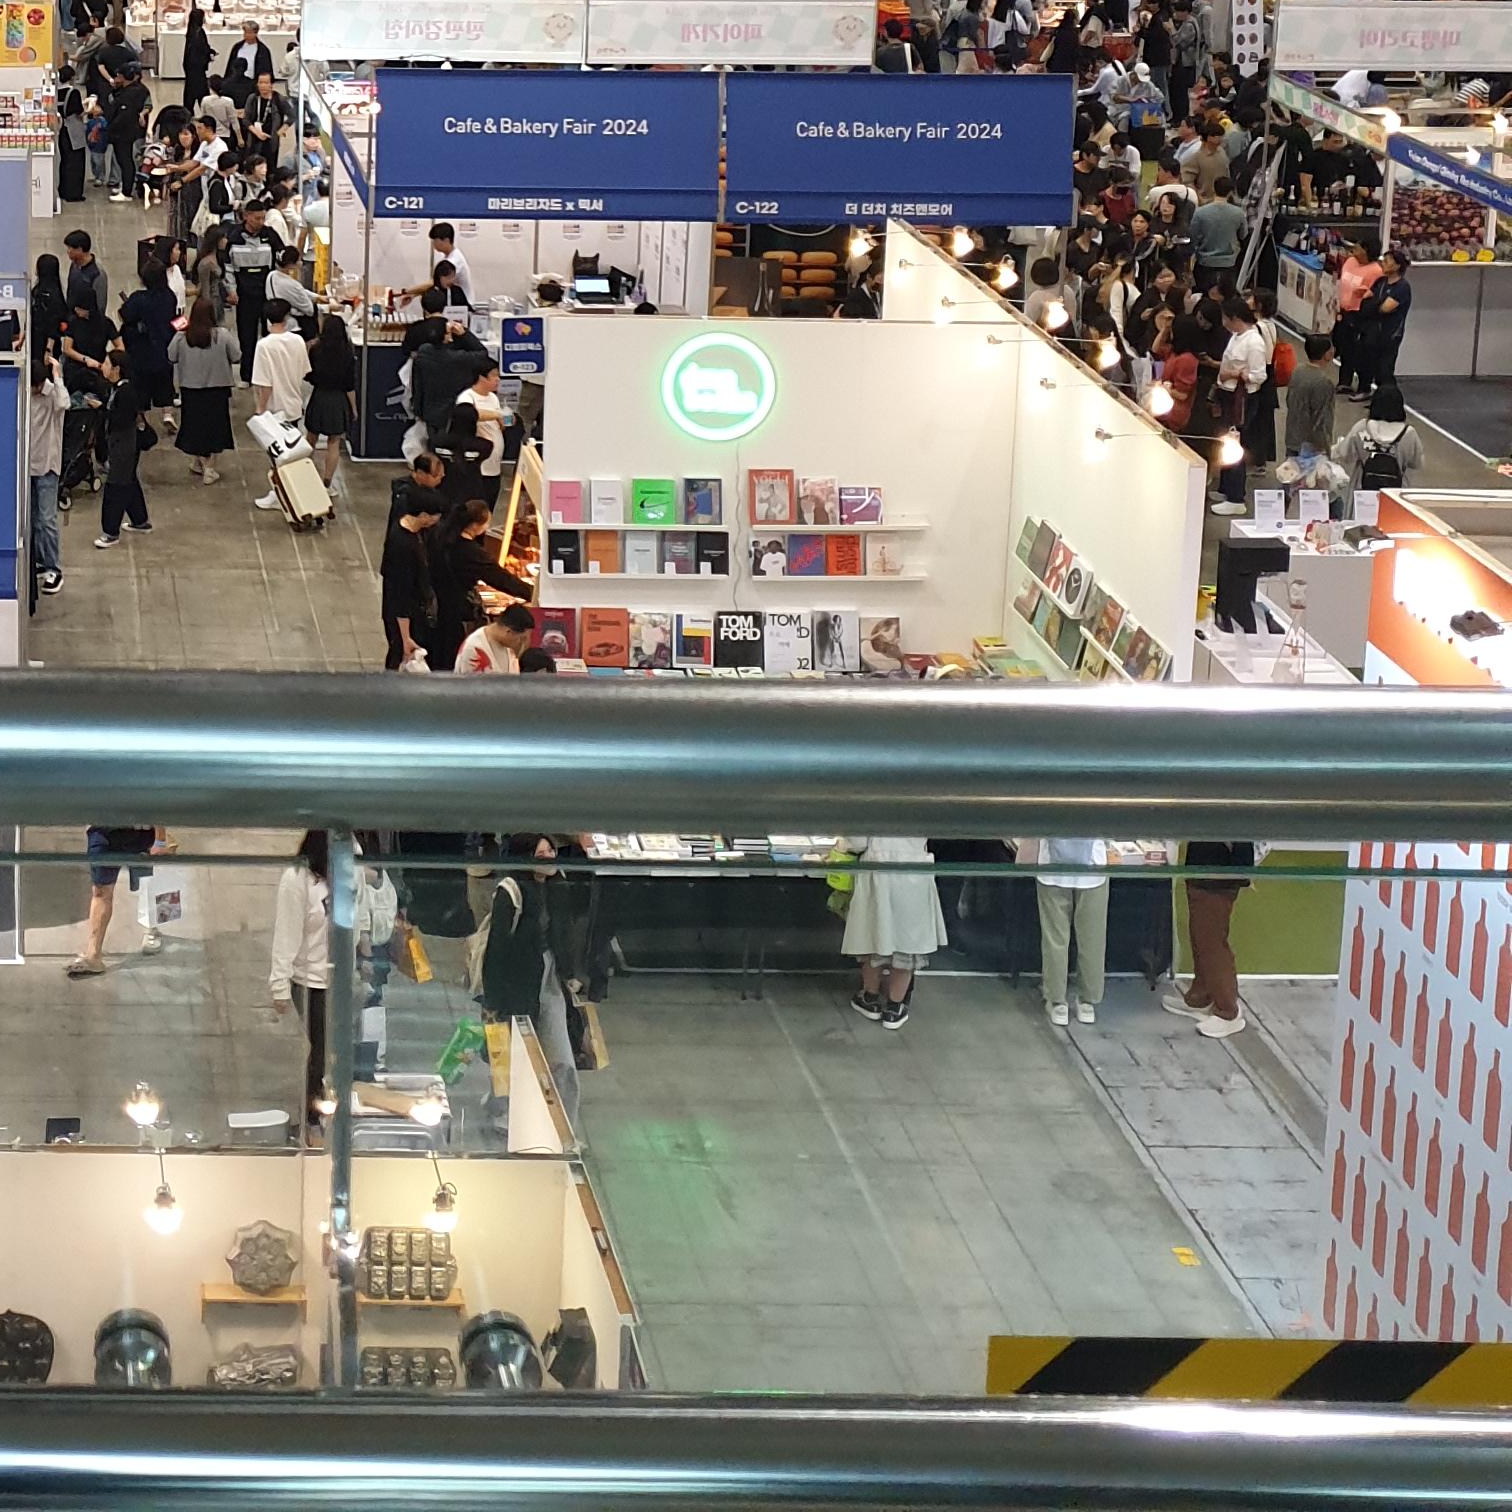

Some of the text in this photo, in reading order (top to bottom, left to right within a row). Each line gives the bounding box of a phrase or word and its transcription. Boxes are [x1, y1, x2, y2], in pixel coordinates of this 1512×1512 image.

[443, 117, 649, 138] Cafe & Bakery Fair 2024
[795, 122, 1003, 143] Cafe & Bakery Fair 2024
[384, 196, 424, 209] C-121
[488, 197, 563, 211] 마리브리자드
[736, 202, 779, 215] C-122
[845, 203, 858, 215] 더
[861, 203, 886, 215] 더치
[719, 615, 754, 628] TOM
[768, 614, 802, 627] TOM
[720, 628, 761, 641] FORD
